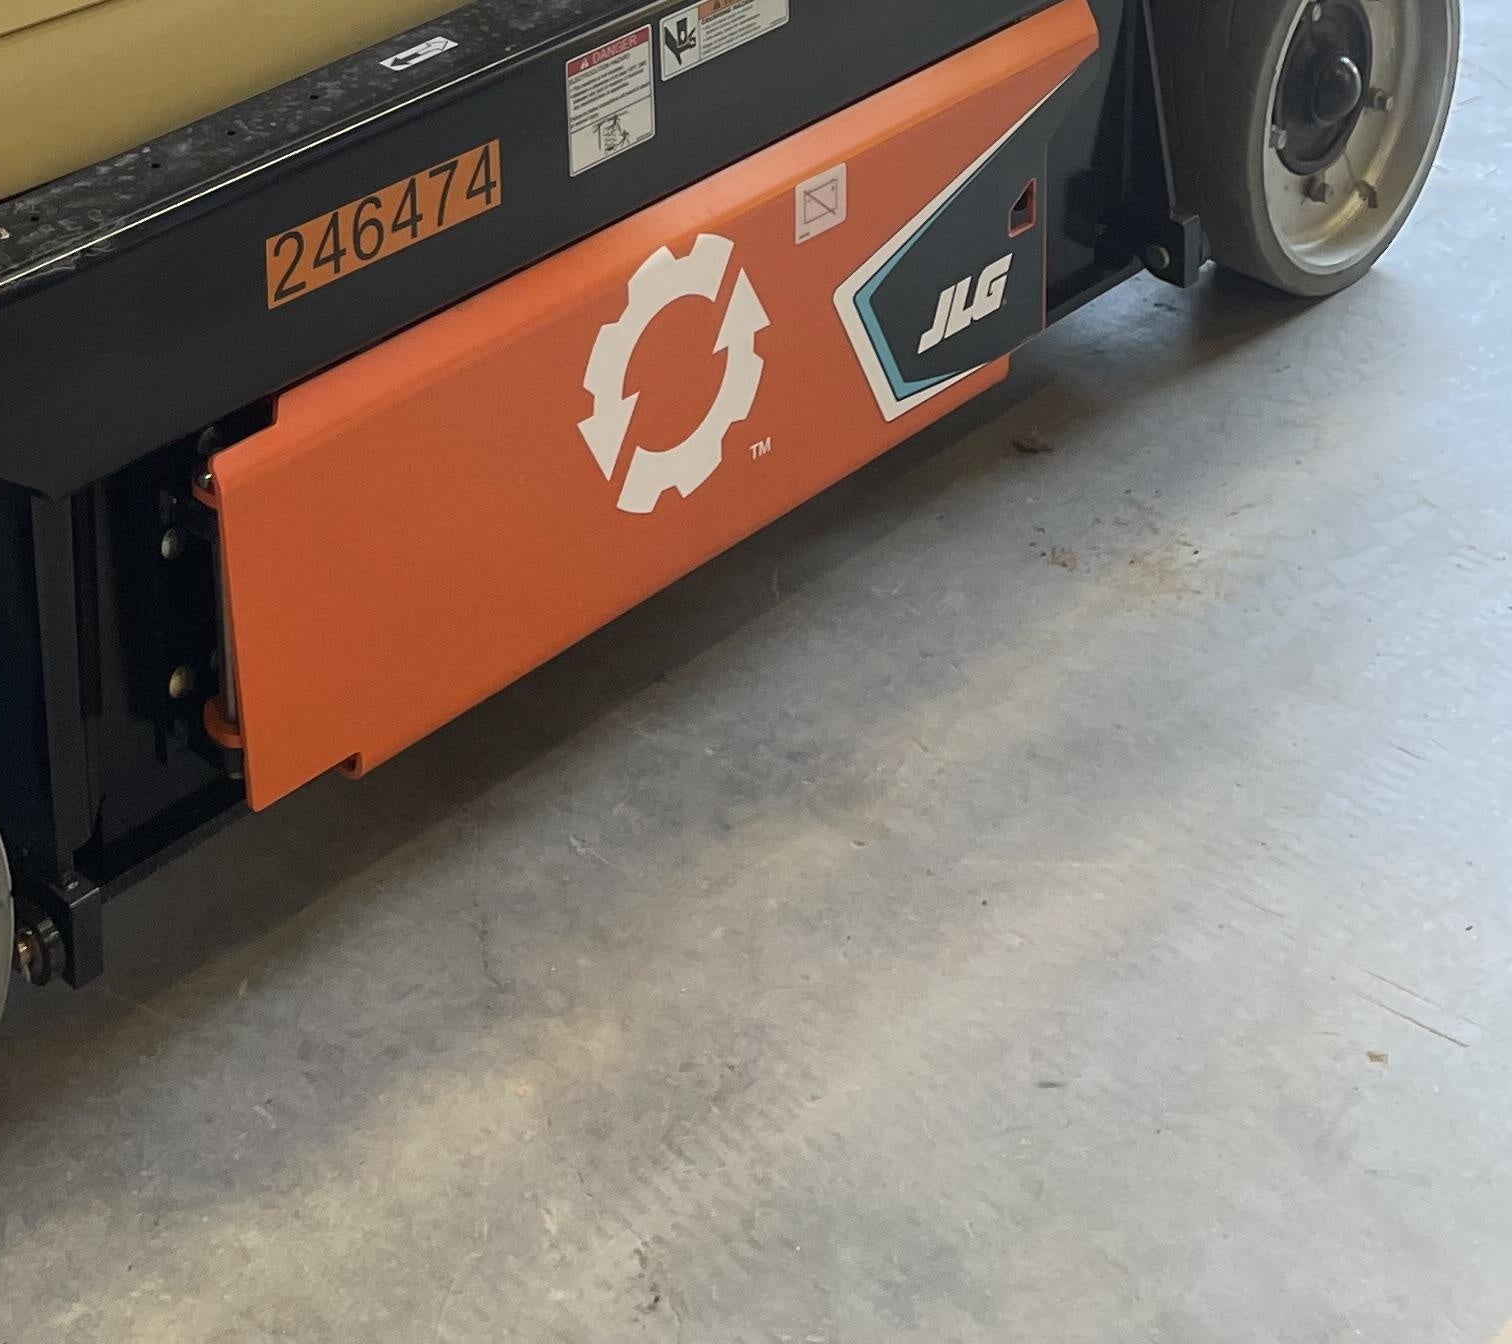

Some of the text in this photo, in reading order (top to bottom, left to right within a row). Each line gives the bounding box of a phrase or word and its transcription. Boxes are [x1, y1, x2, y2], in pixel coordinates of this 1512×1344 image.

[592, 35, 637, 62] DANGER
[273, 143, 497, 300] 246474
[917, 252, 1013, 355] JLG
[750, 437, 772, 461] TM
